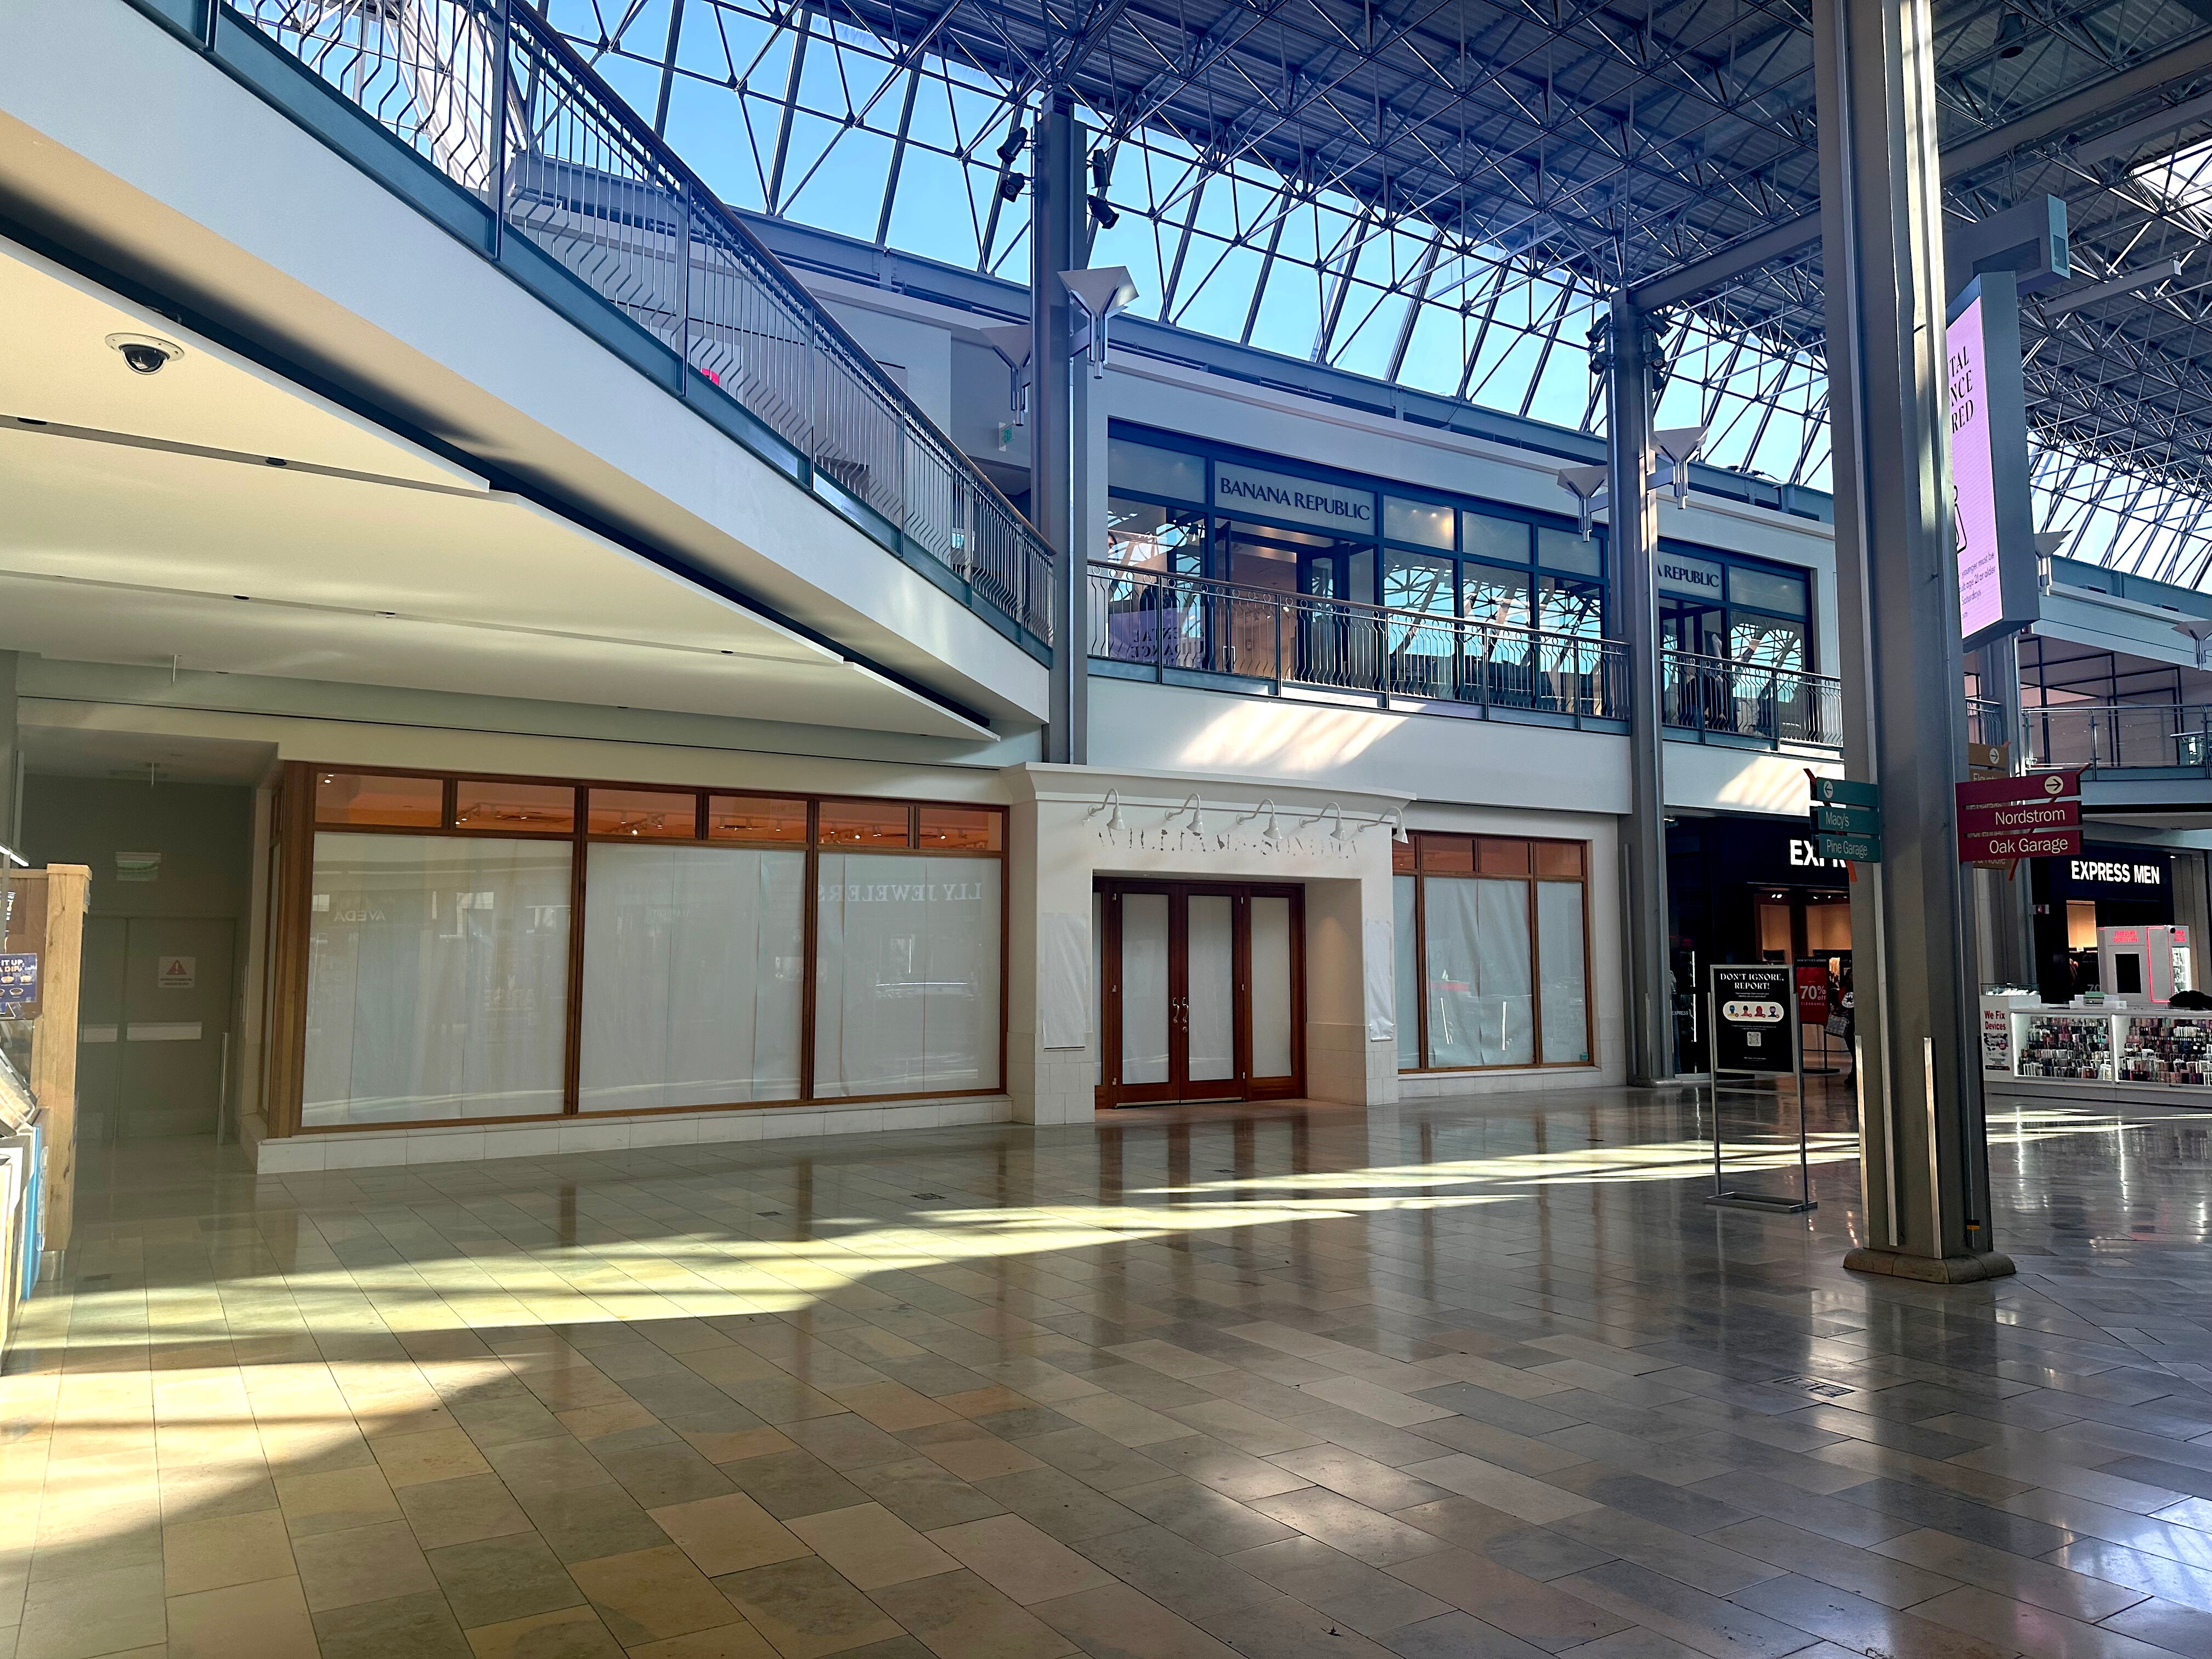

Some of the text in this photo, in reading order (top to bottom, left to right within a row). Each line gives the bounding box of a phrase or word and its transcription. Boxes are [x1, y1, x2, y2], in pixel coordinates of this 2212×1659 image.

[1949, 346, 1969, 377] TAL
[1950, 369, 1973, 407] NCE
[1951, 399, 1973, 434] RED
[1221, 477, 1370, 521] BANANA REPUBLIC
[1664, 565, 1719, 588] REPUBLIC
[1974, 574, 1979, 584] 21
[1825, 811, 1849, 829] Macy's
[1995, 809, 2066, 826] Nordstrom
[1826, 839, 1867, 859] Pine Garage
[1989, 838, 2068, 854] Oak Garage
[2071, 860, 2160, 884] EXPRESS MEN
[1749, 973, 1784, 981] IGNORE,
[1799, 985, 1826, 1000] 70%
[1984, 1011, 2006, 1020] We Fix
[1985, 1021, 2006, 1030] Devices
